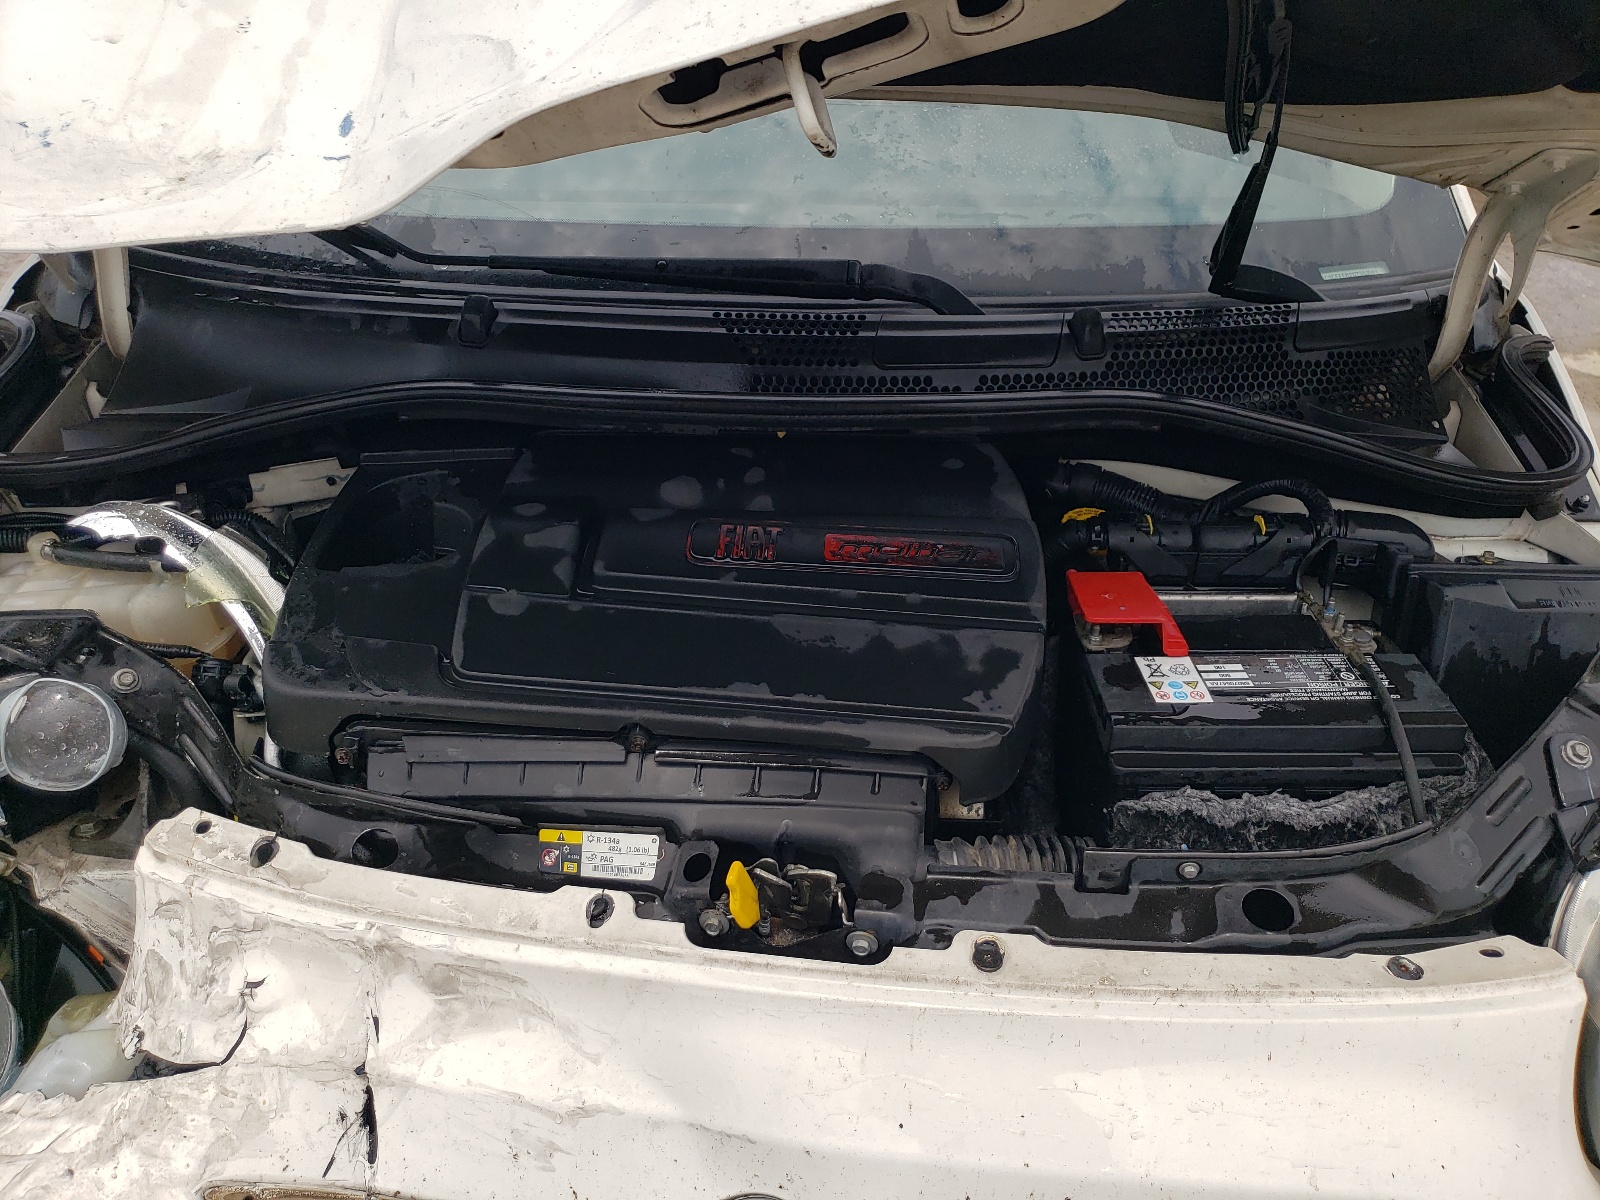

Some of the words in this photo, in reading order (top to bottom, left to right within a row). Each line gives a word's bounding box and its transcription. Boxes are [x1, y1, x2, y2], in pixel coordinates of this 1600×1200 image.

[715, 524, 784, 560] FIAT
[596, 836, 620, 845] R-134a
[600, 855, 614, 863] PAG
